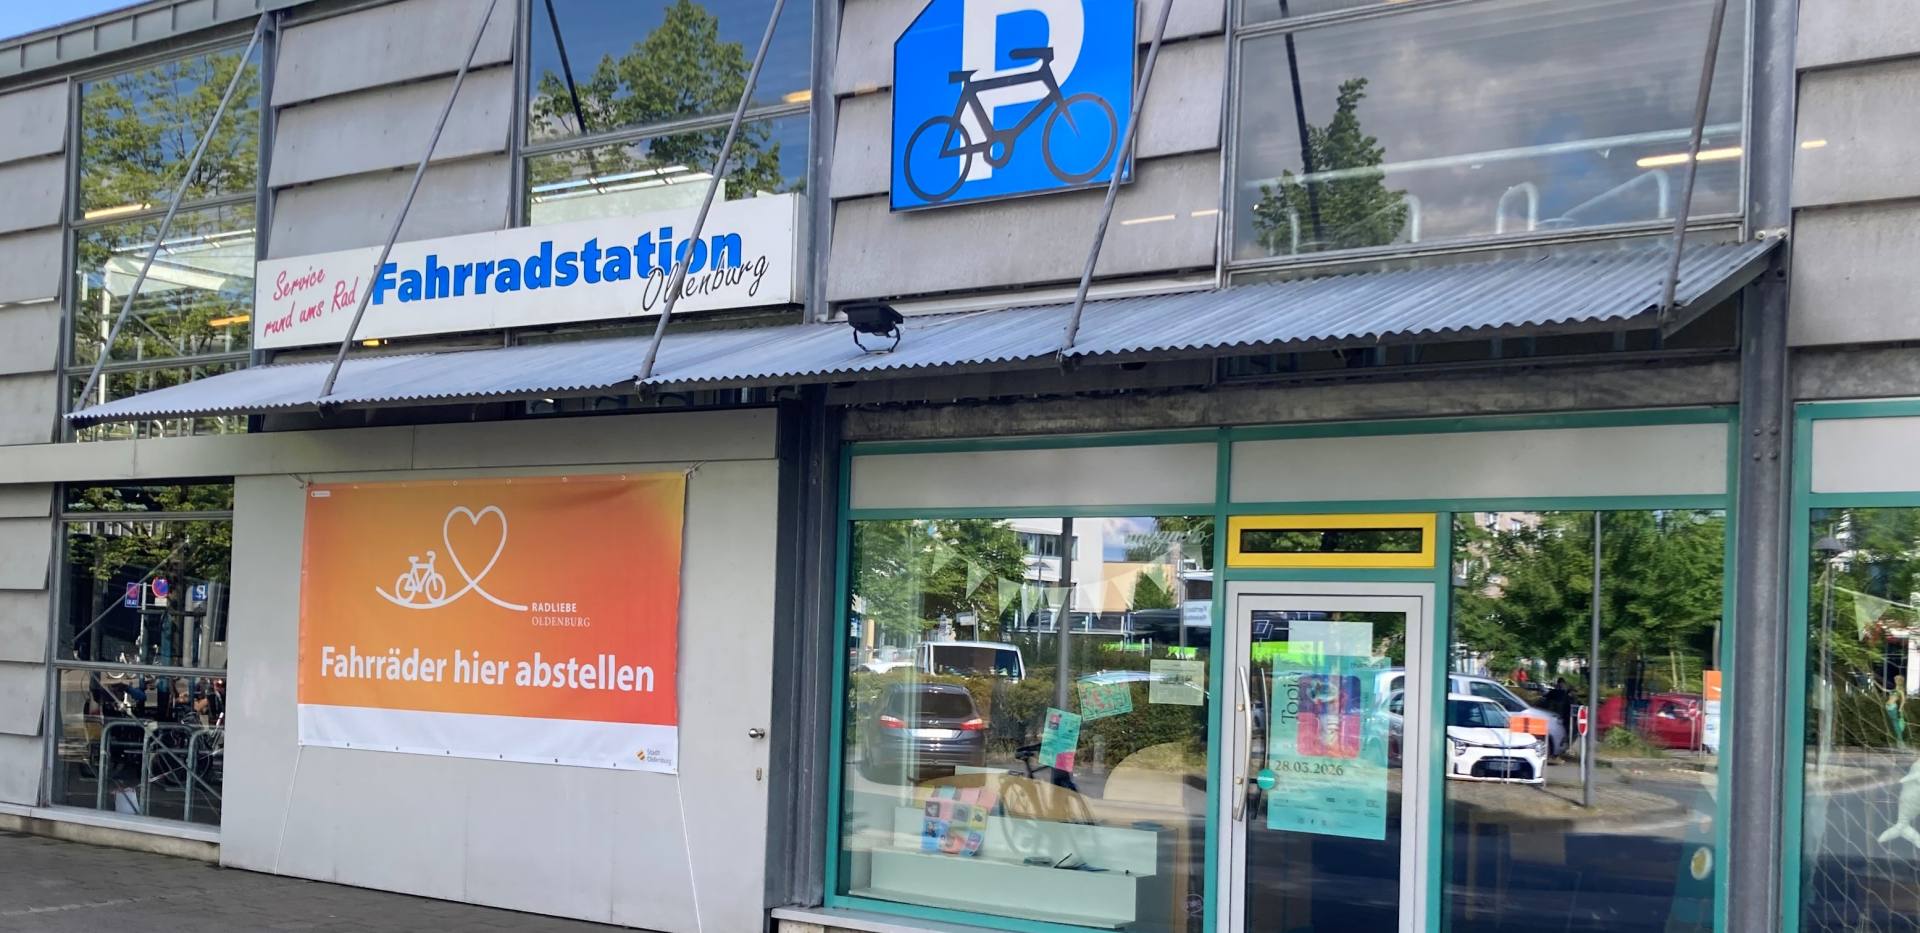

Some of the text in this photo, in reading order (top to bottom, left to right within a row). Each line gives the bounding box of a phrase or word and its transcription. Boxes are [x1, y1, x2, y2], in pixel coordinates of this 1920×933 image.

[960, 0, 1084, 182] P
[273, 266, 325, 301] Service
[373, 226, 742, 305] Fahrradstation
[643, 255, 769, 311] Olenburg
[264, 276, 359, 337] rund ums Rad
[531, 602, 577, 613] RADLIEBE
[531, 616, 592, 627] OLDENBURG
[321, 645, 654, 692] Fahrräder hier abstellen
